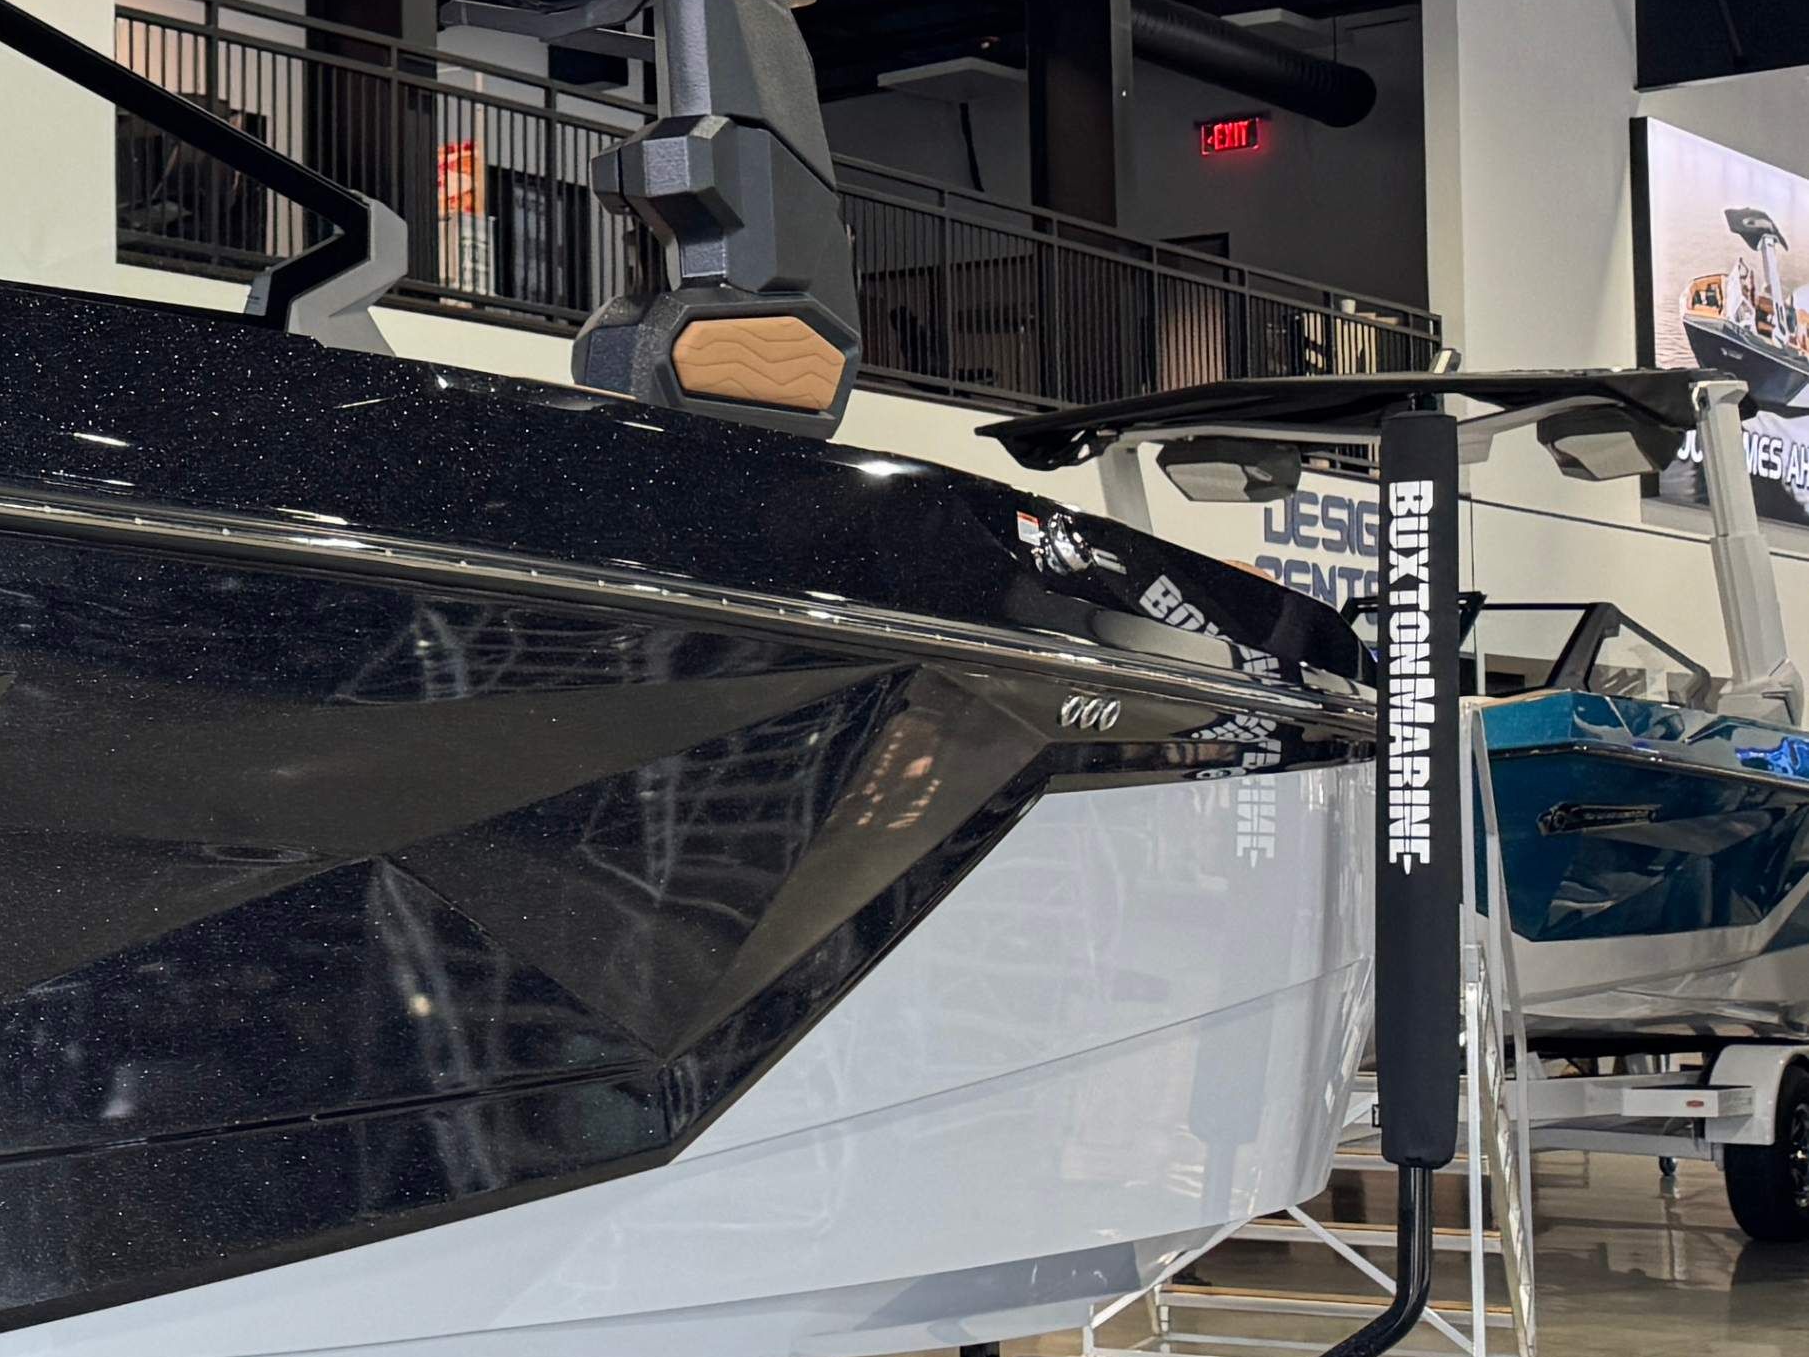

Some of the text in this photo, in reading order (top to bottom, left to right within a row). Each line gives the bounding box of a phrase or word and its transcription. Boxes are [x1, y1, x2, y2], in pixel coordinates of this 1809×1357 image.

[1213, 120, 1250, 151] EXIT
[1264, 490, 1379, 558] DESIG
[1388, 479, 1434, 875] BUXTONMARINE
